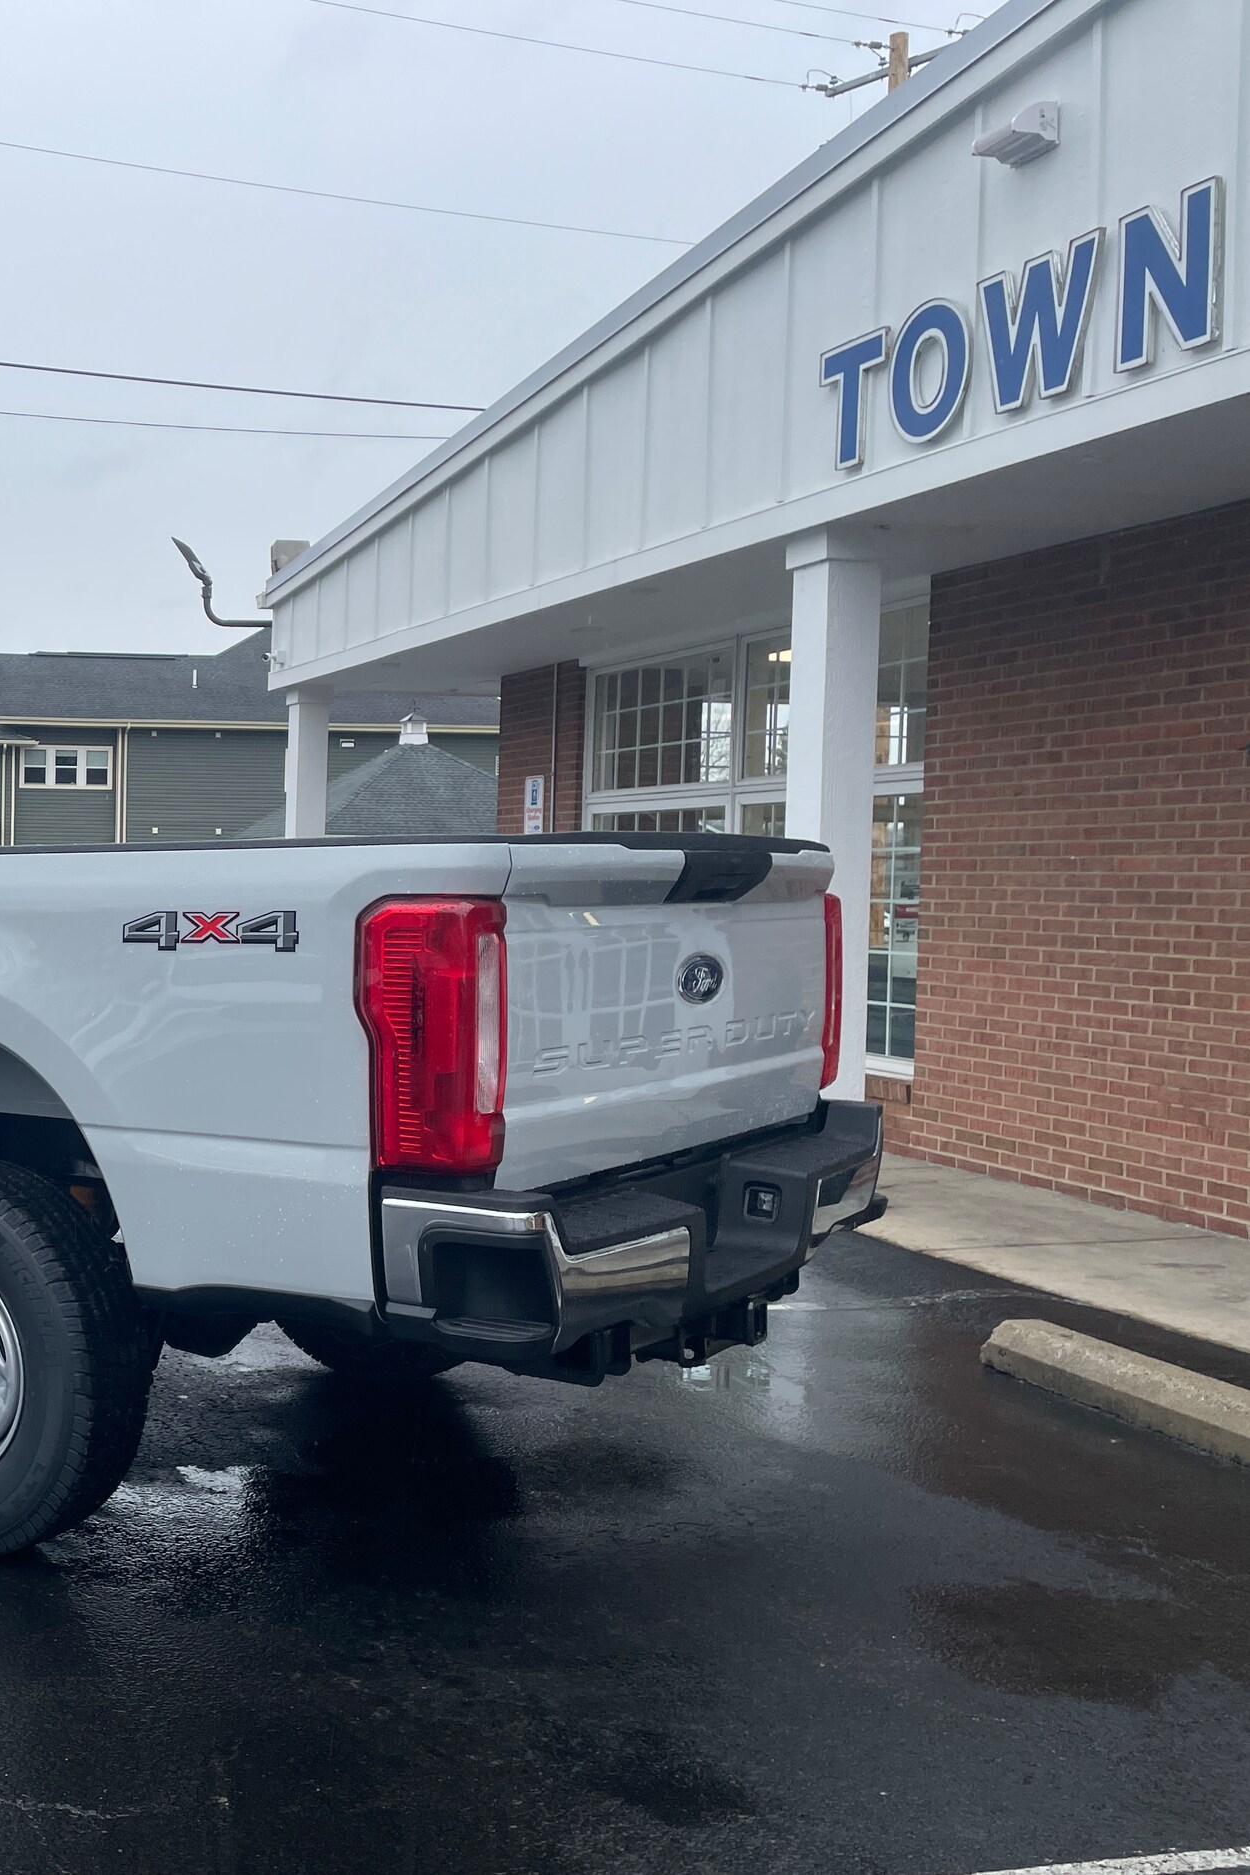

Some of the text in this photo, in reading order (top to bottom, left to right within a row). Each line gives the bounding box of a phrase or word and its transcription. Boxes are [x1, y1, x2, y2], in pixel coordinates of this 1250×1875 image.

[819, 175, 1224, 471] TOWN
[692, 966, 718, 993] Ford
[533, 1009, 816, 1078] SUPER DUTY
